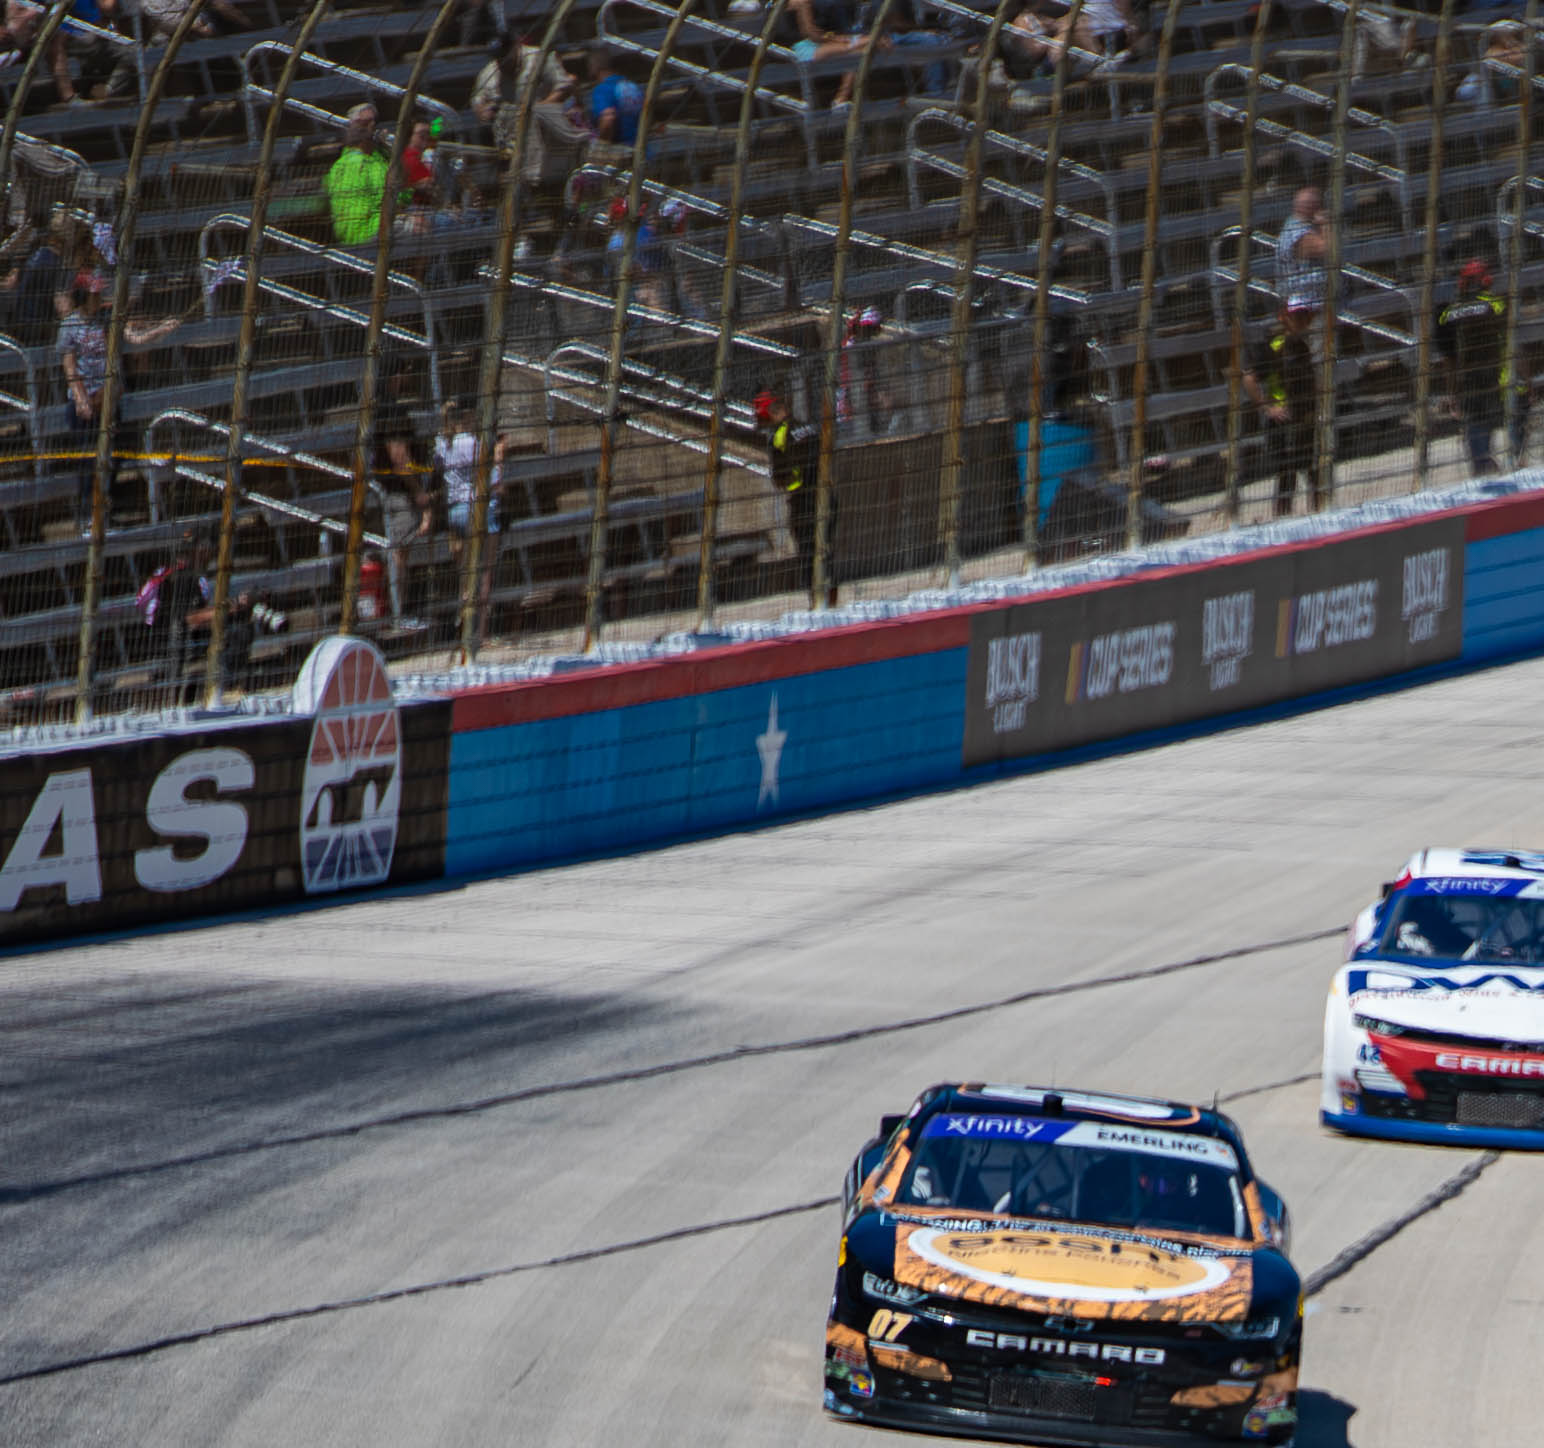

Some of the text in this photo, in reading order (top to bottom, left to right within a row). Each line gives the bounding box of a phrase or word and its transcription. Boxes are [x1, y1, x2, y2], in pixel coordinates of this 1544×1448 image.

[1403, 548, 1451, 614] BUSCH
[1202, 590, 1255, 661] BUSCH
[1298, 579, 1379, 654] CUP SERIES
[986, 632, 1041, 703] BUSCH
[1086, 622, 1176, 700] CUP SERIES
[947, 1115, 1047, 1139] xfinity
[1097, 1130, 1209, 1155] EMERLING
[867, 1308, 914, 1342] 07
[966, 1329, 1167, 1365] CAMARO
